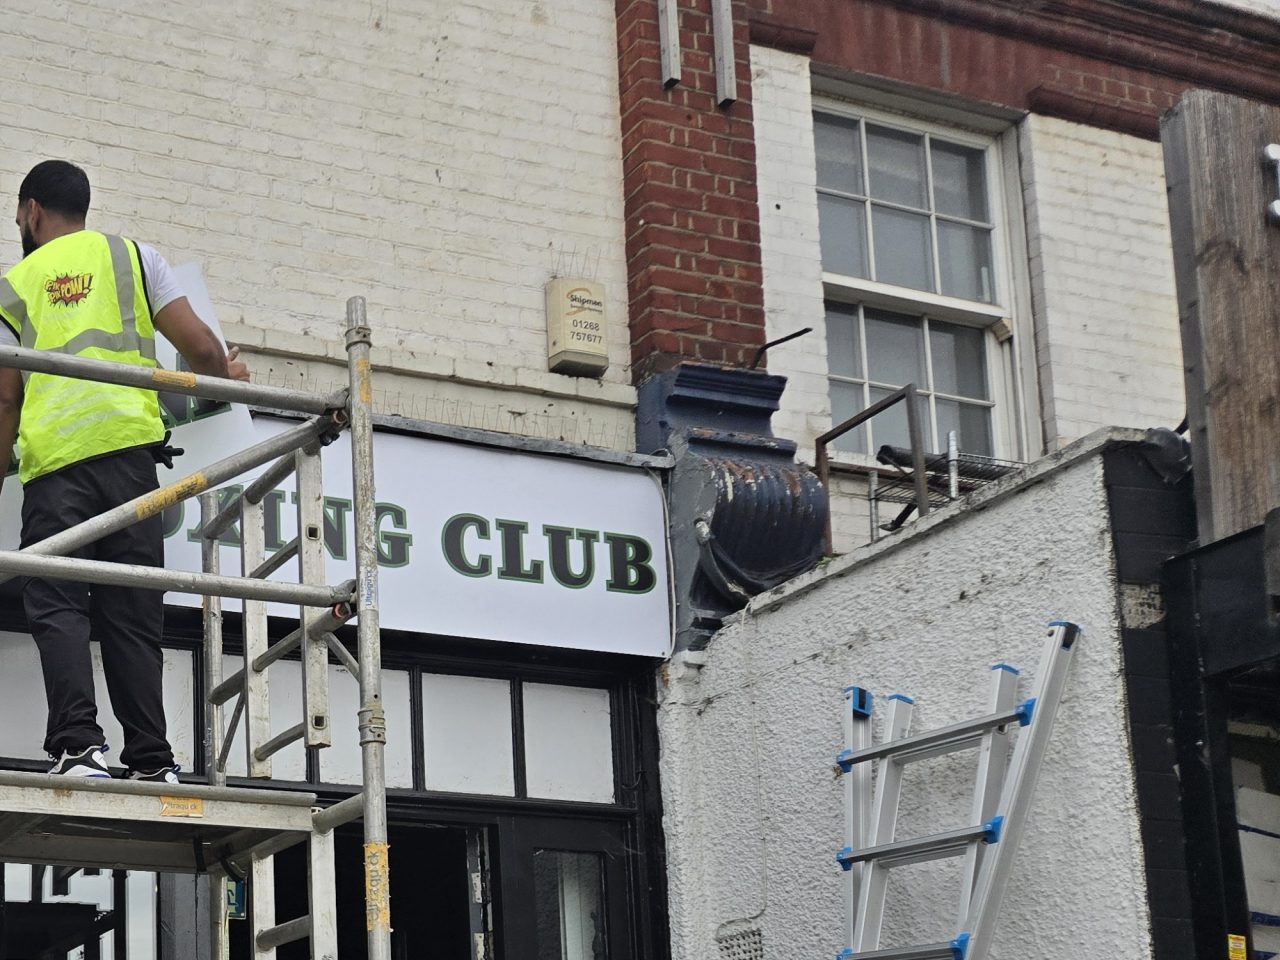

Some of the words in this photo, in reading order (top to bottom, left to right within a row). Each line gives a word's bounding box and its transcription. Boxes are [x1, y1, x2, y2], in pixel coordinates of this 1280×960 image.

[572, 319, 600, 331] 01268
[570, 331, 602, 344] 757677
[442, 513, 658, 594] CLUB
